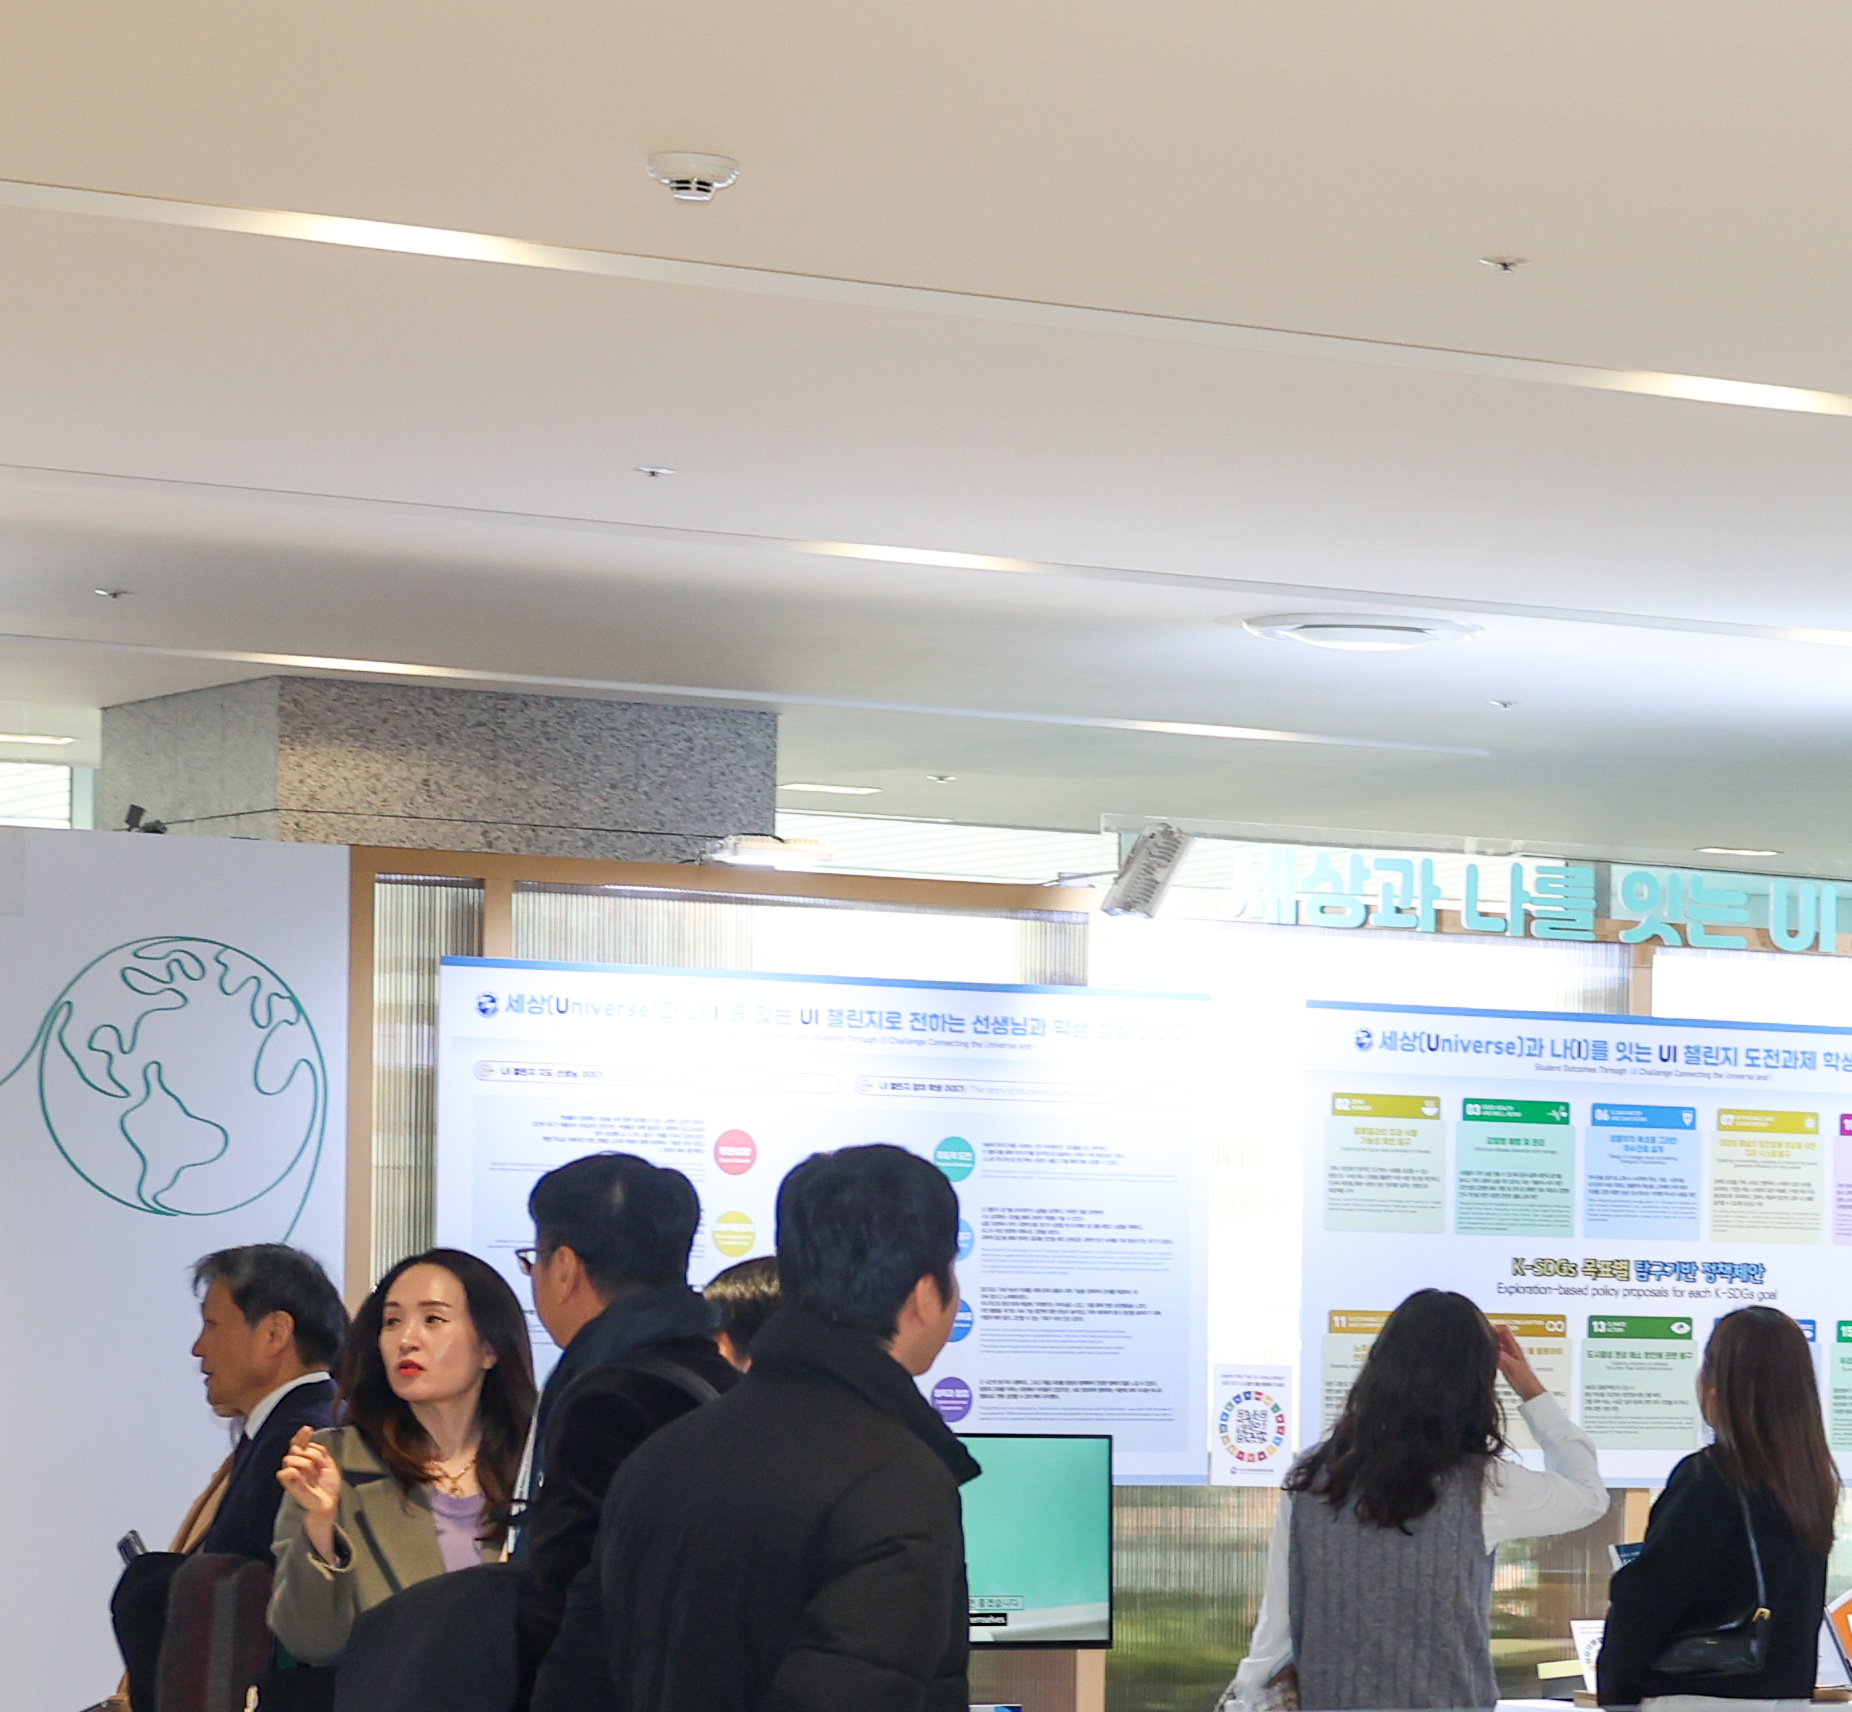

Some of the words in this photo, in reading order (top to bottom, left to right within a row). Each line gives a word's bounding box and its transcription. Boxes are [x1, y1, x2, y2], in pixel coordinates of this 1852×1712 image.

[1231, 847, 1442, 934] 세상과
[1460, 861, 1598, 941] 나를
[1618, 870, 1751, 948] 잇는
[1768, 880, 1838, 954] UI
[800, 1008, 819, 1026] UI
[826, 1008, 902, 1032] 챌린지로
[909, 1011, 966, 1034] 전하는
[971, 1014, 1047, 1037] 선생님과
[1055, 1018, 1089, 1038] 학생
[1378, 1030, 1545, 1058] 세상(Universe)과
[1550, 1037, 1609, 1062] 나(I)를
[1616, 1040, 1653, 1063] 잇는
[1657, 1044, 1678, 1063] UI
[1683, 1044, 1738, 1067] 챌린지
[1744, 1048, 1817, 1071] 도전과제
[1511, 1256, 1578, 1277] K-SDGs
[1581, 1258, 1630, 1281] 목표별
[1633, 1260, 1698, 1283] 탐구기반
[1700, 1262, 1766, 1285] 정책제안
[1672, 1287, 1687, 1297] for
[1689, 1288, 1711, 1299] each
[1592, 1321, 1606, 1333] 13
